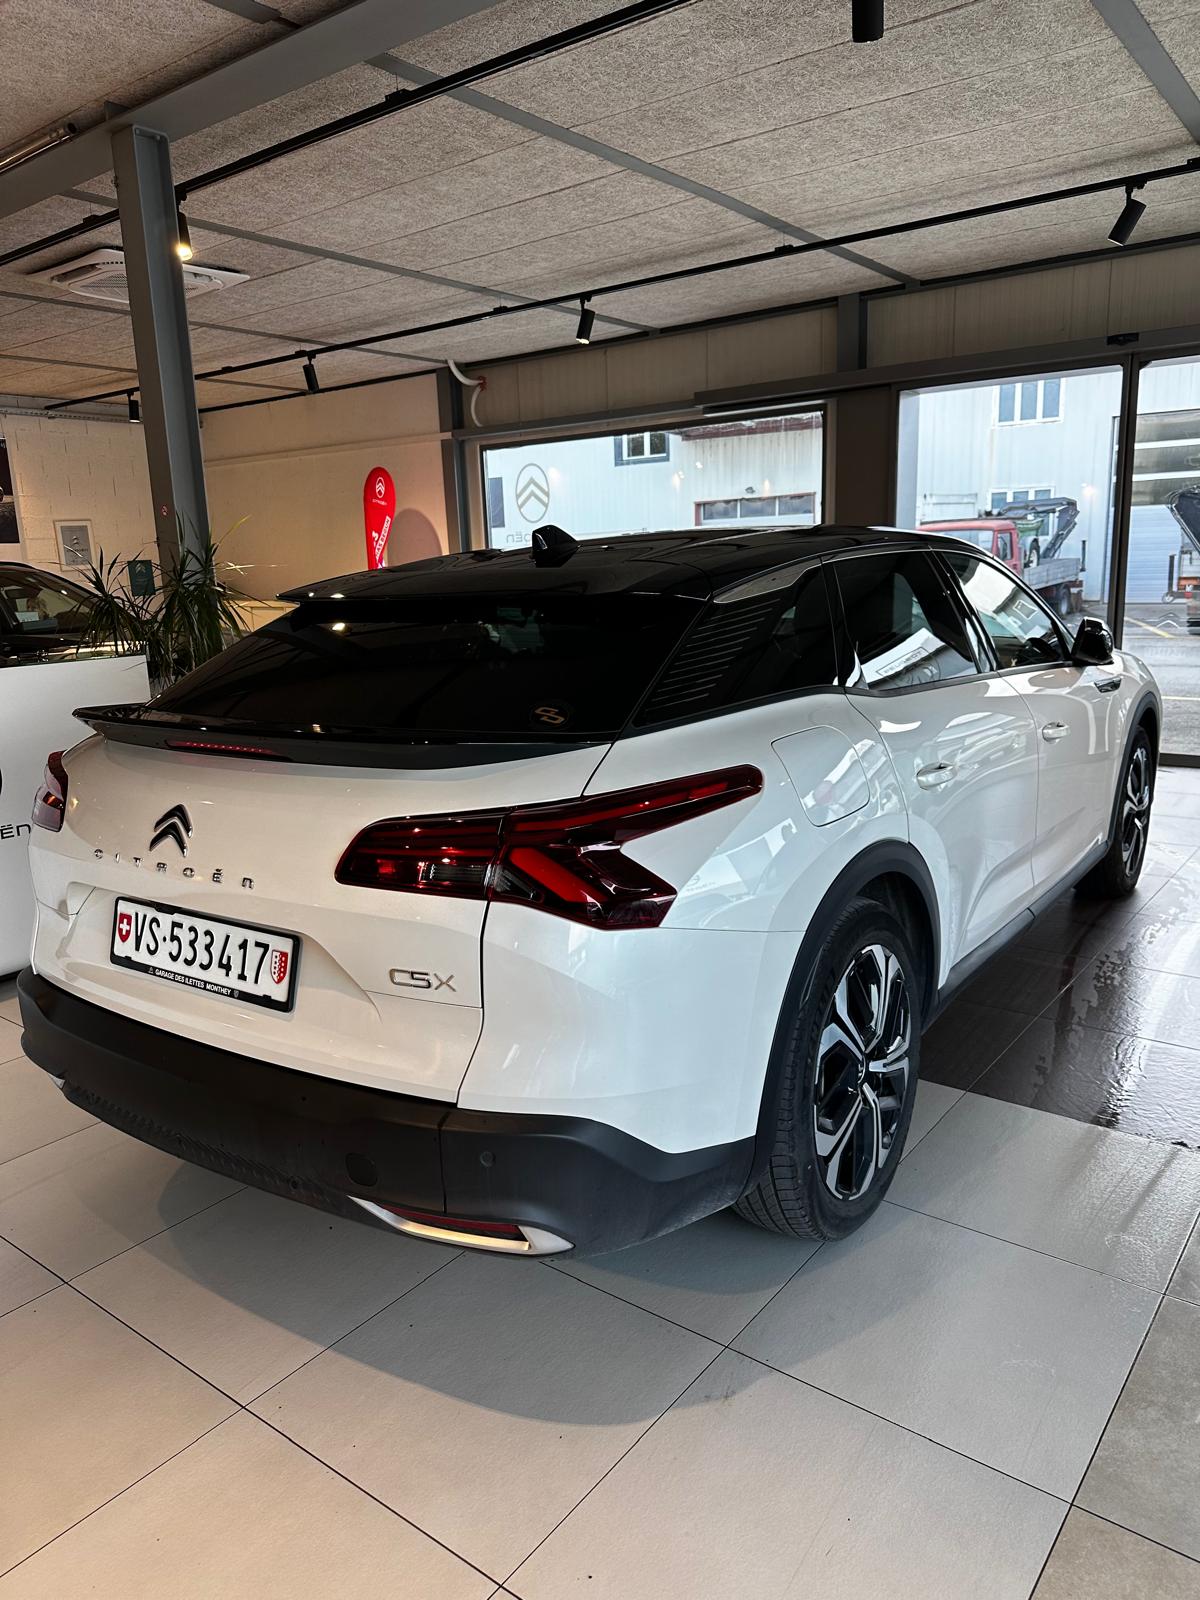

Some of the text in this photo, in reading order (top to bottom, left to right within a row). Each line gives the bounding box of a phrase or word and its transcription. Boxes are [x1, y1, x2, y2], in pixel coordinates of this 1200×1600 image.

[155, 968, 231, 996] GARAGE DES ILETTES MONTHEY
